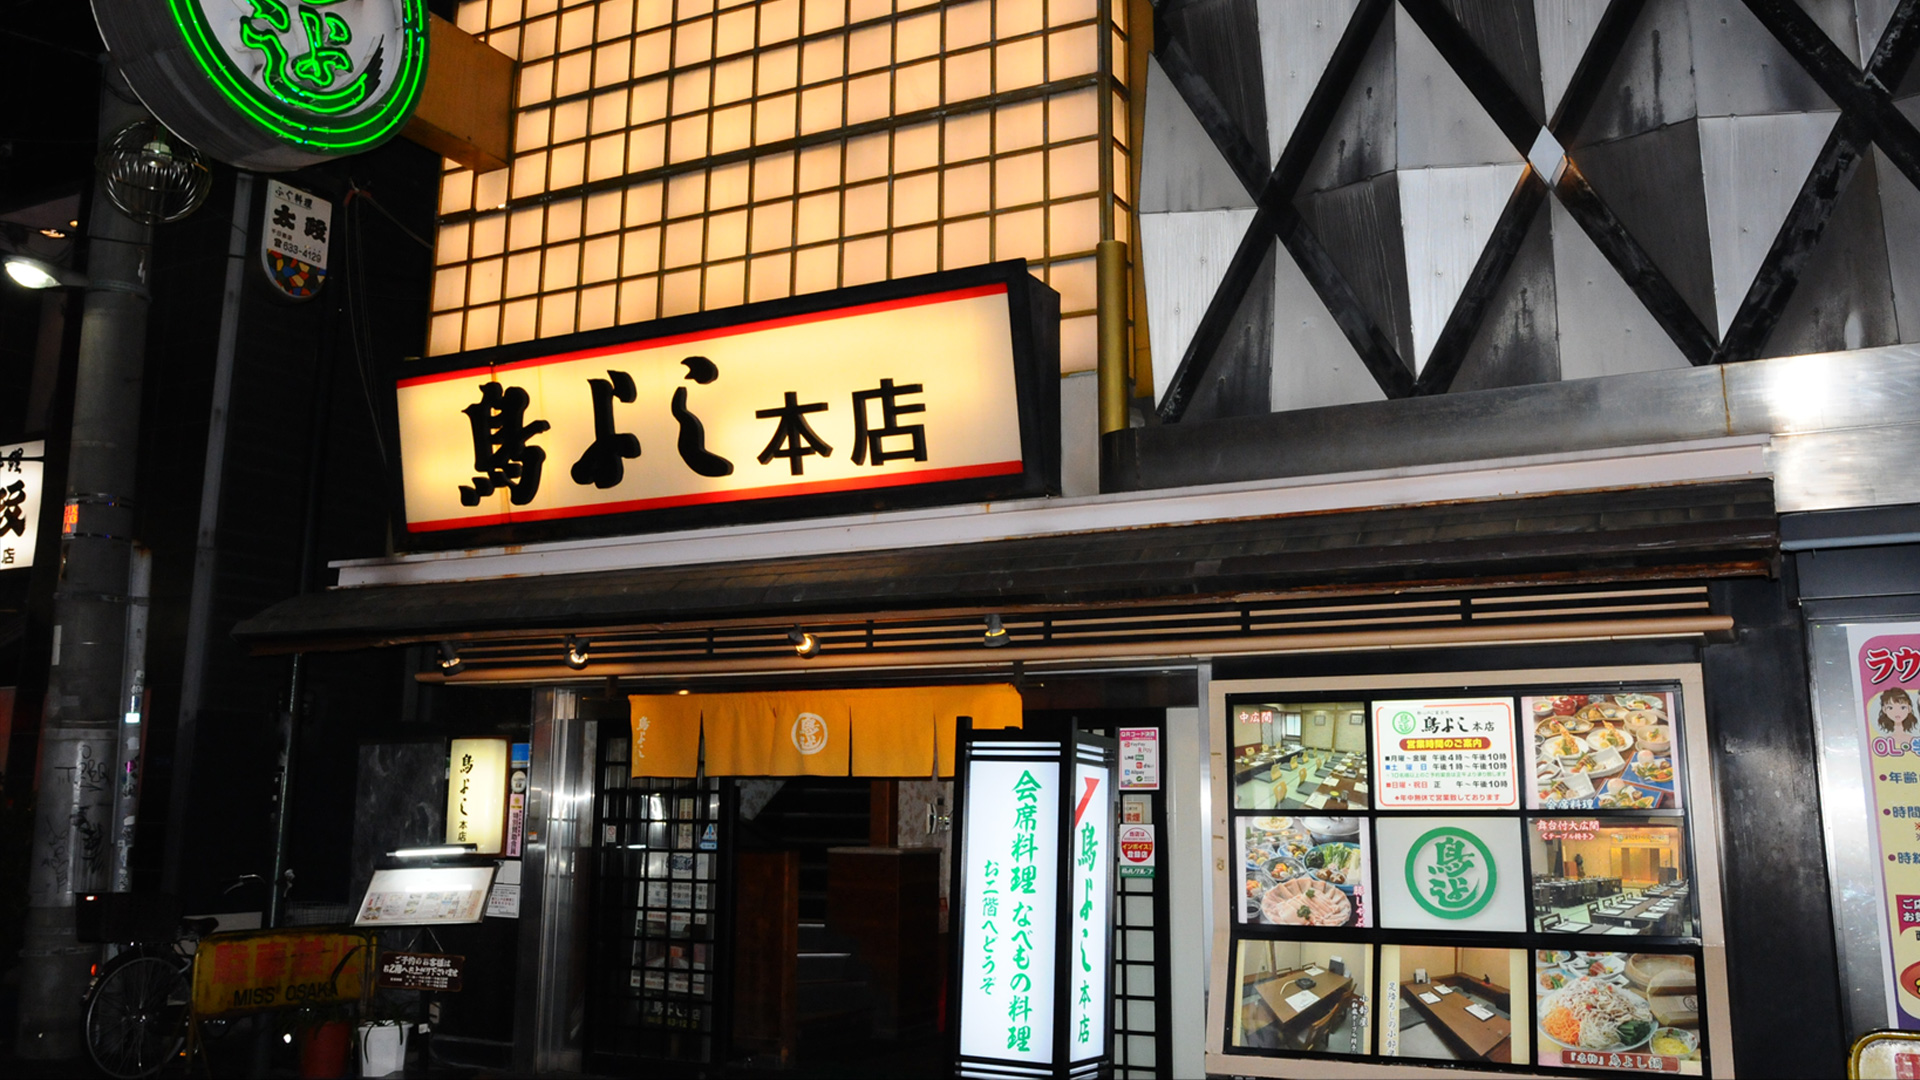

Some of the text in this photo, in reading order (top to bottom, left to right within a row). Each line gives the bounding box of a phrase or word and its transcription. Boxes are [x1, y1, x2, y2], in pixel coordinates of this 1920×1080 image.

[275, 186, 313, 209] ふぐ料理
[283, 241, 322, 263] 633-4129
[458, 355, 928, 507] 鳥よし本店
[0, 448, 24, 474] 理
[1239, 711, 1273, 724] 中広間
[1421, 716, 1495, 734] 鳥よし本店
[1406, 738, 1483, 749] 営業時間のご案内
[1888, 771, 1920, 784] 年齢
[457, 753, 475, 842] 鳥よし本店
[1546, 799, 1595, 809] 会席料理
[1536, 819, 1600, 832] 舞台付大広間
[1006, 769, 1043, 1053] 会席料理 なべもの料理
[979, 858, 1000, 996] お二階へどうぞ
[1076, 821, 1099, 1044] 鳥よし本店
[285, 981, 338, 1002] OSAKA
